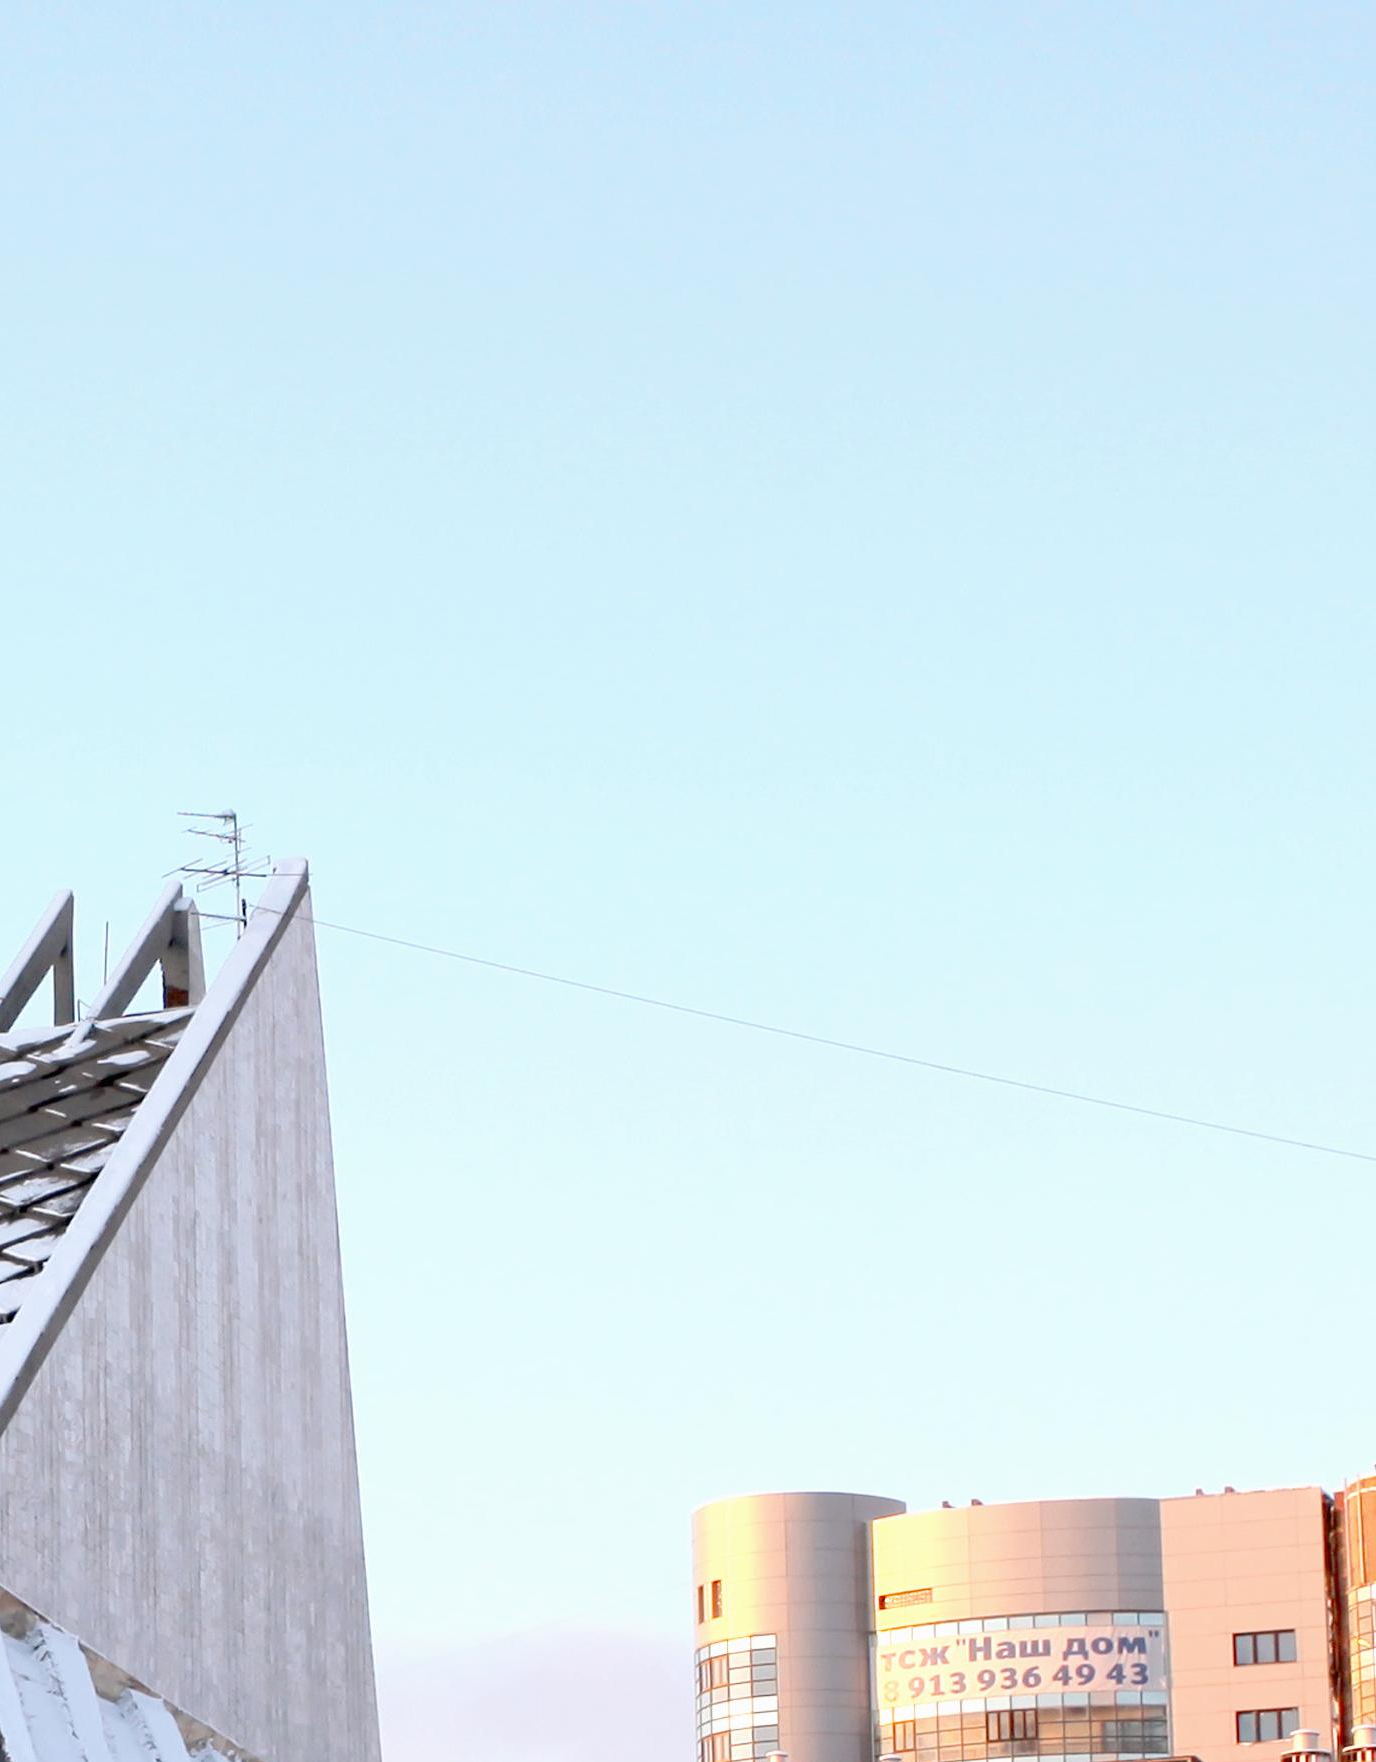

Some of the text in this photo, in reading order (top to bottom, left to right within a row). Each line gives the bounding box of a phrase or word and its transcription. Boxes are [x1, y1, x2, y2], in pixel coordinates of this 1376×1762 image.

[956, 1635, 1051, 1662] "Наш
[1062, 1630, 1160, 1661] дом"
[884, 1663, 1149, 1702] 8 913 936 49 43
